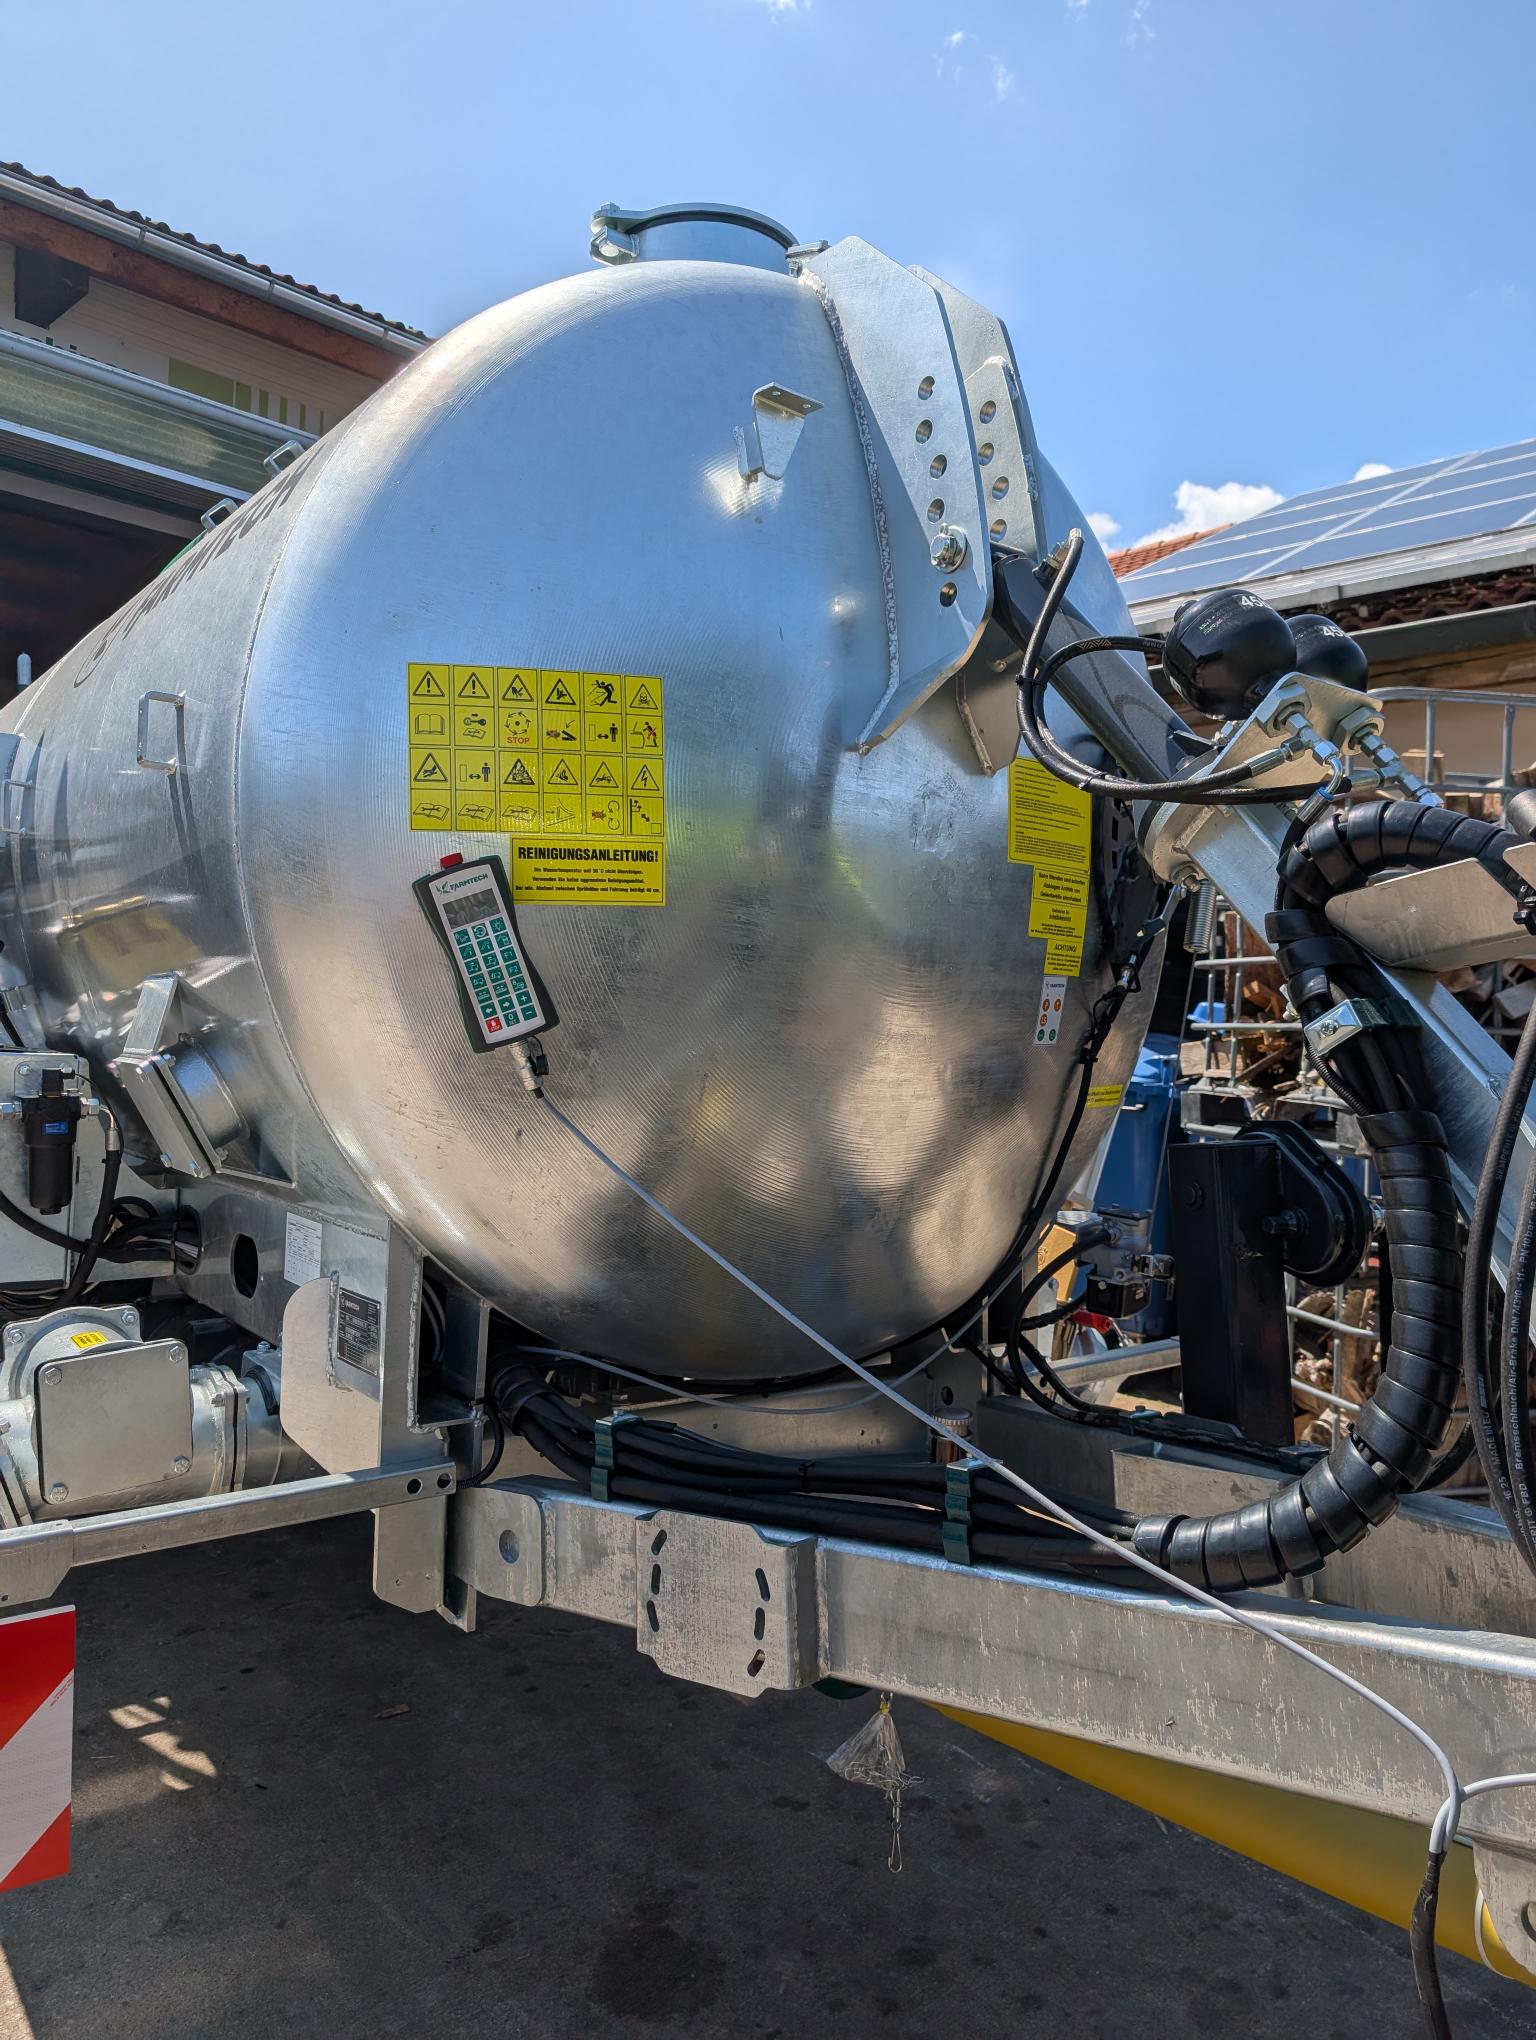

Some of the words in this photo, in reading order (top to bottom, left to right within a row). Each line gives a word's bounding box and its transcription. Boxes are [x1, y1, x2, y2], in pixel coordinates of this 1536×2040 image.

[506, 736, 529, 744] STOP
[518, 847, 659, 862] REINIGUNGSANLEITUNG!
[450, 873, 488, 891] FARMTECH
[504, 951, 513, 959] F1
[509, 966, 518, 974] F2
[1512, 1290, 1522, 1315] 74310
[1511, 1317, 1519, 1333] DIN
[1486, 1437, 1501, 1465] MADE
[1499, 1476, 1508, 1488] 25
[1519, 1483, 1530, 1505] FBD
